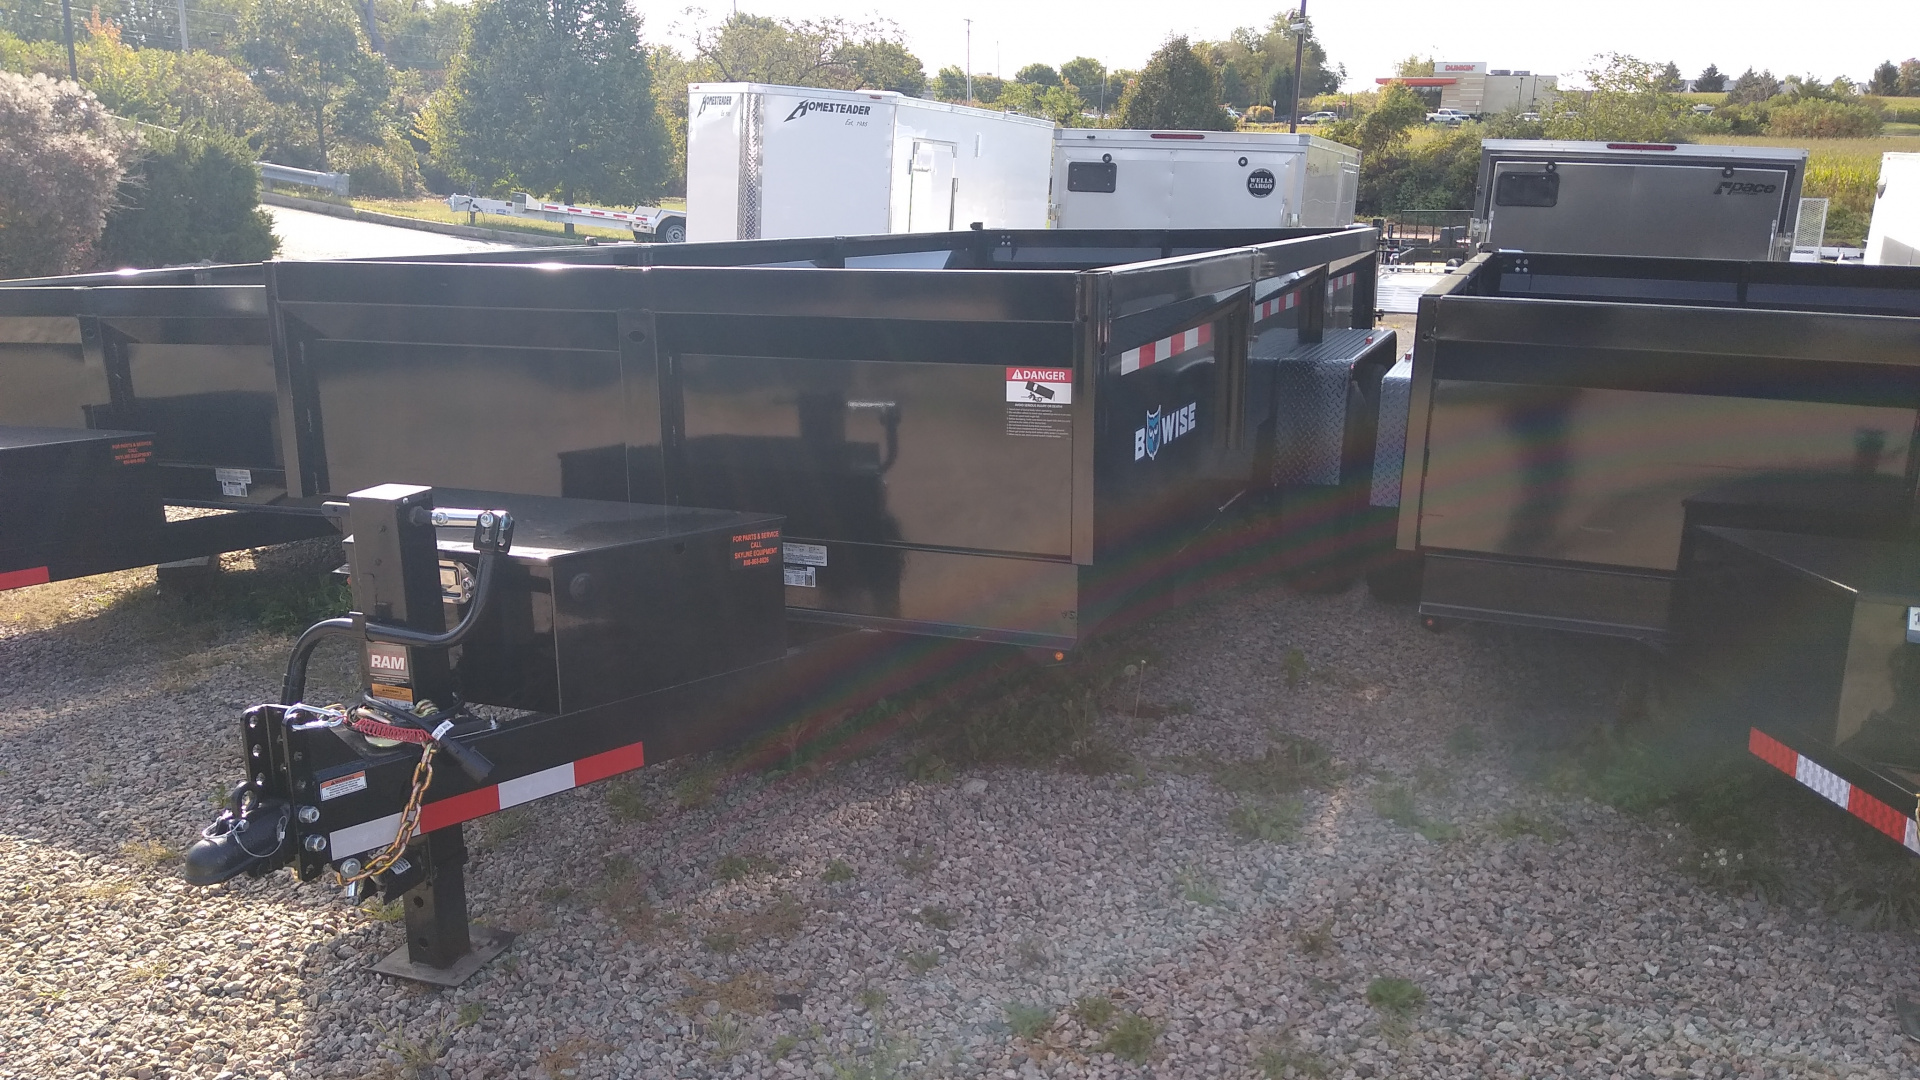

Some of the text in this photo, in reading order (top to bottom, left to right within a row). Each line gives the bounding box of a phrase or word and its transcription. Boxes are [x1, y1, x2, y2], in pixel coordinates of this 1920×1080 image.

[784, 99, 871, 123] HOMESTEADER
[1023, 370, 1066, 381] DANGER
[742, 533, 756, 541] PARTS
[761, 530, 779, 539] SERVICE
[371, 654, 405, 670] RAM
